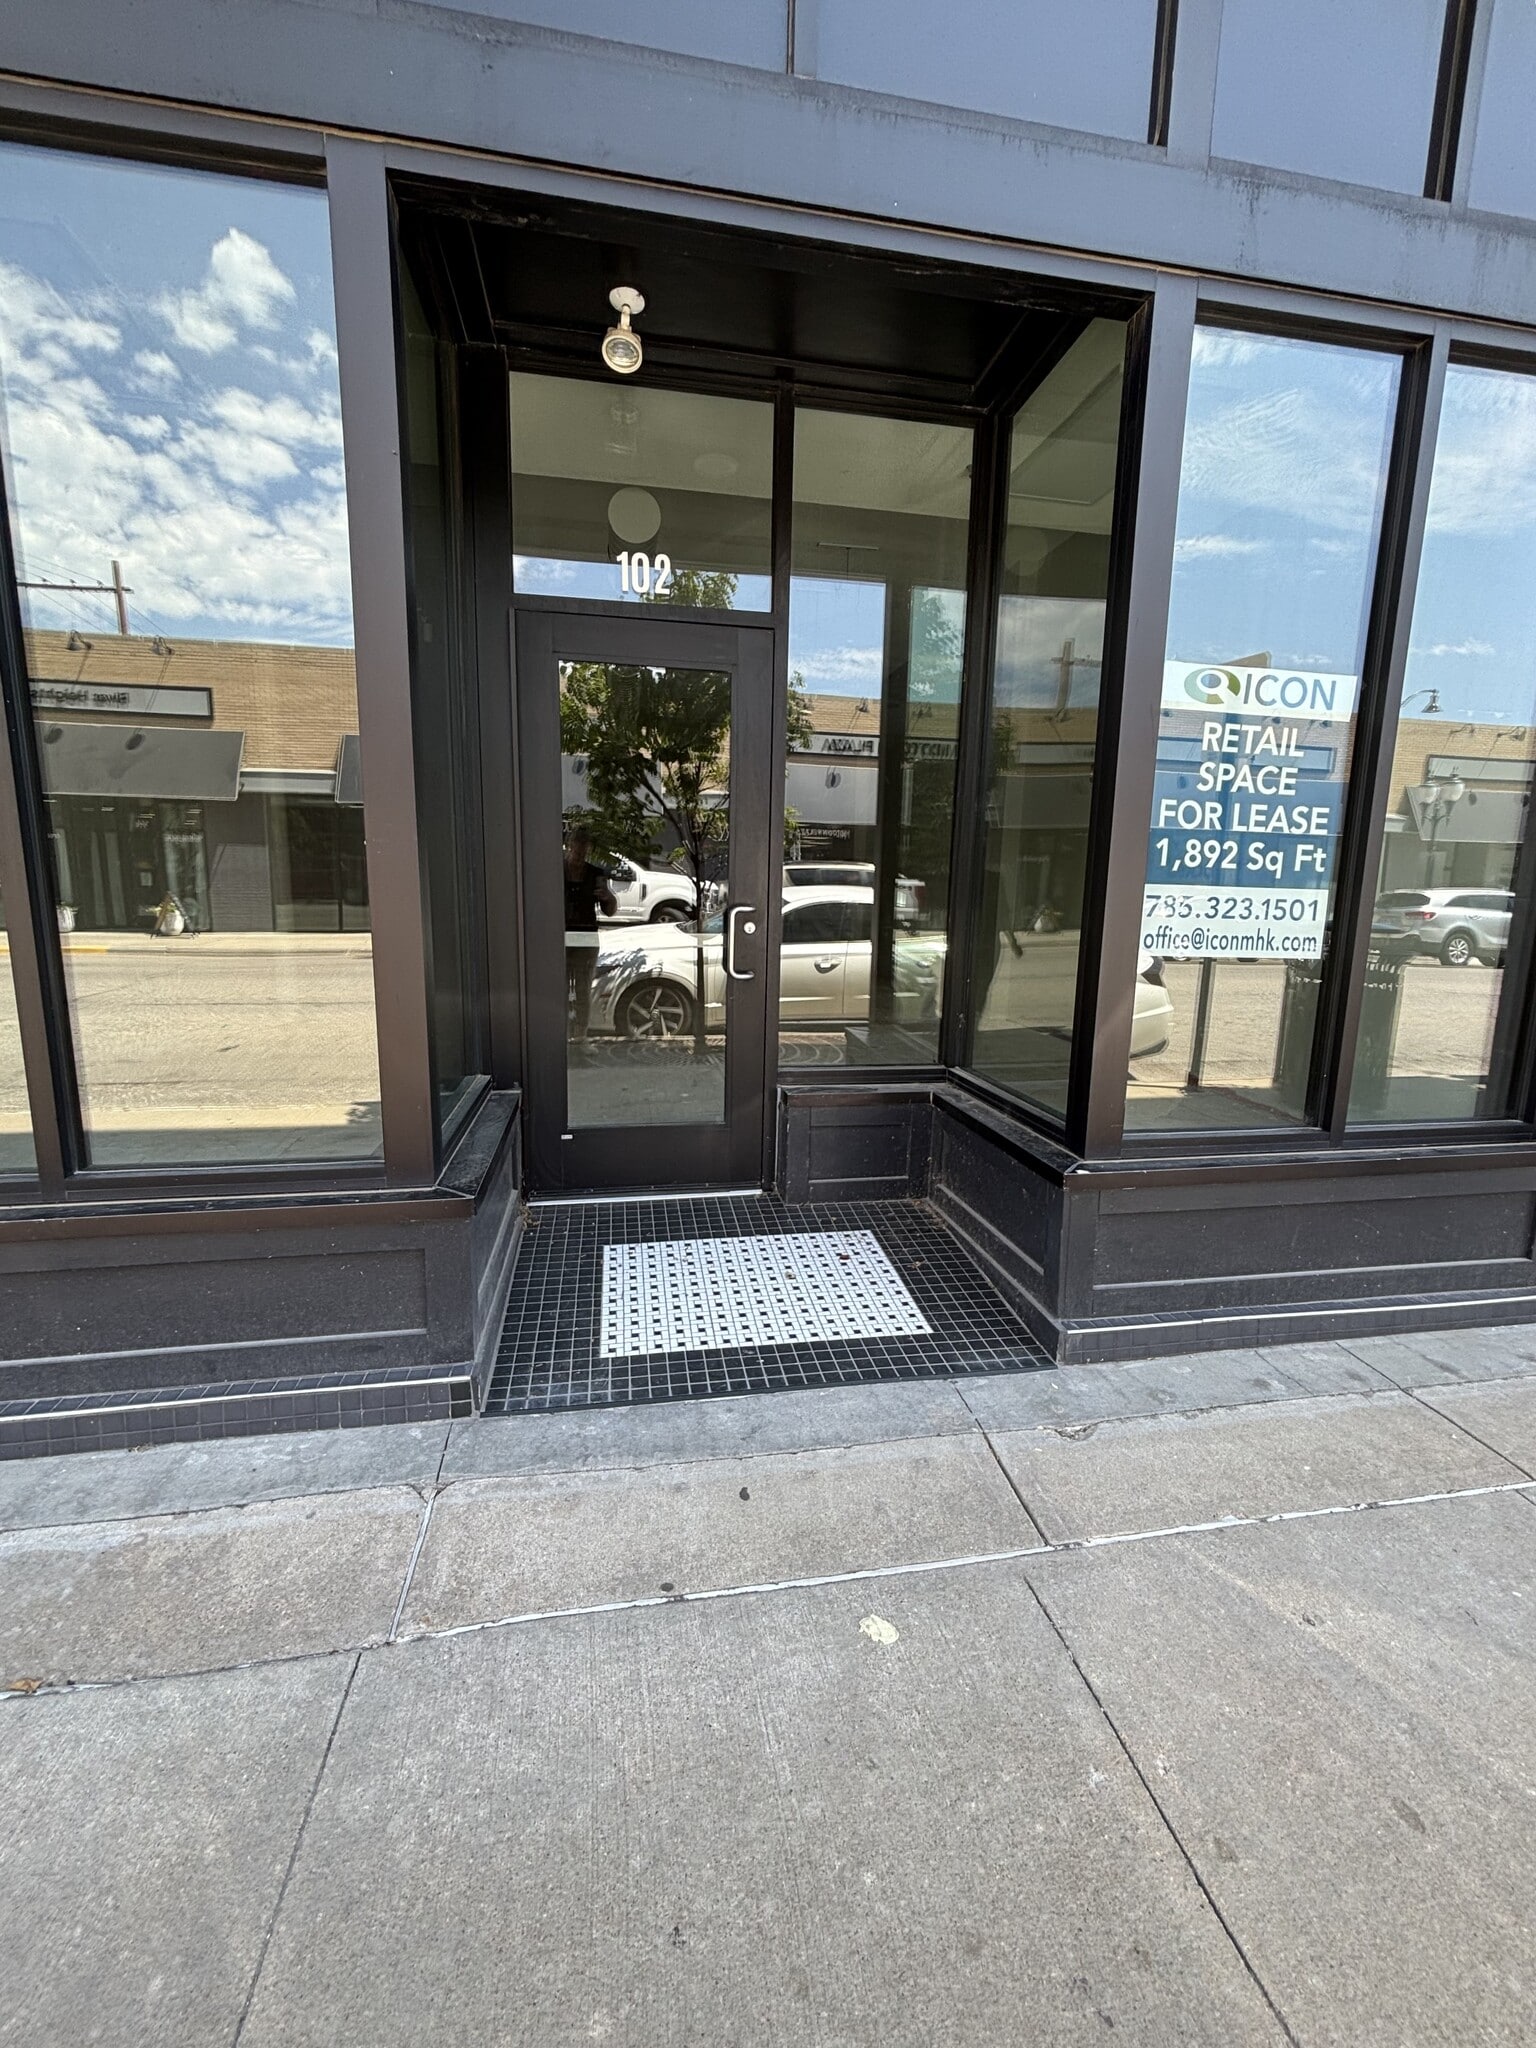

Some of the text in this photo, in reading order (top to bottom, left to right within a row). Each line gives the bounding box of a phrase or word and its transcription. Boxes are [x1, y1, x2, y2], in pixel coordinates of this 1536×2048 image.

[616, 551, 671, 595] 102
[1243, 673, 1337, 711] ICON
[1201, 721, 1304, 758] RETAIL
[1196, 762, 1298, 796] SPACE
[1158, 798, 1330, 835] FOR LEASE
[1155, 837, 1327, 879] 1,892 Sq Ft
[1143, 925, 1317, 952] office@iconmhk.com
